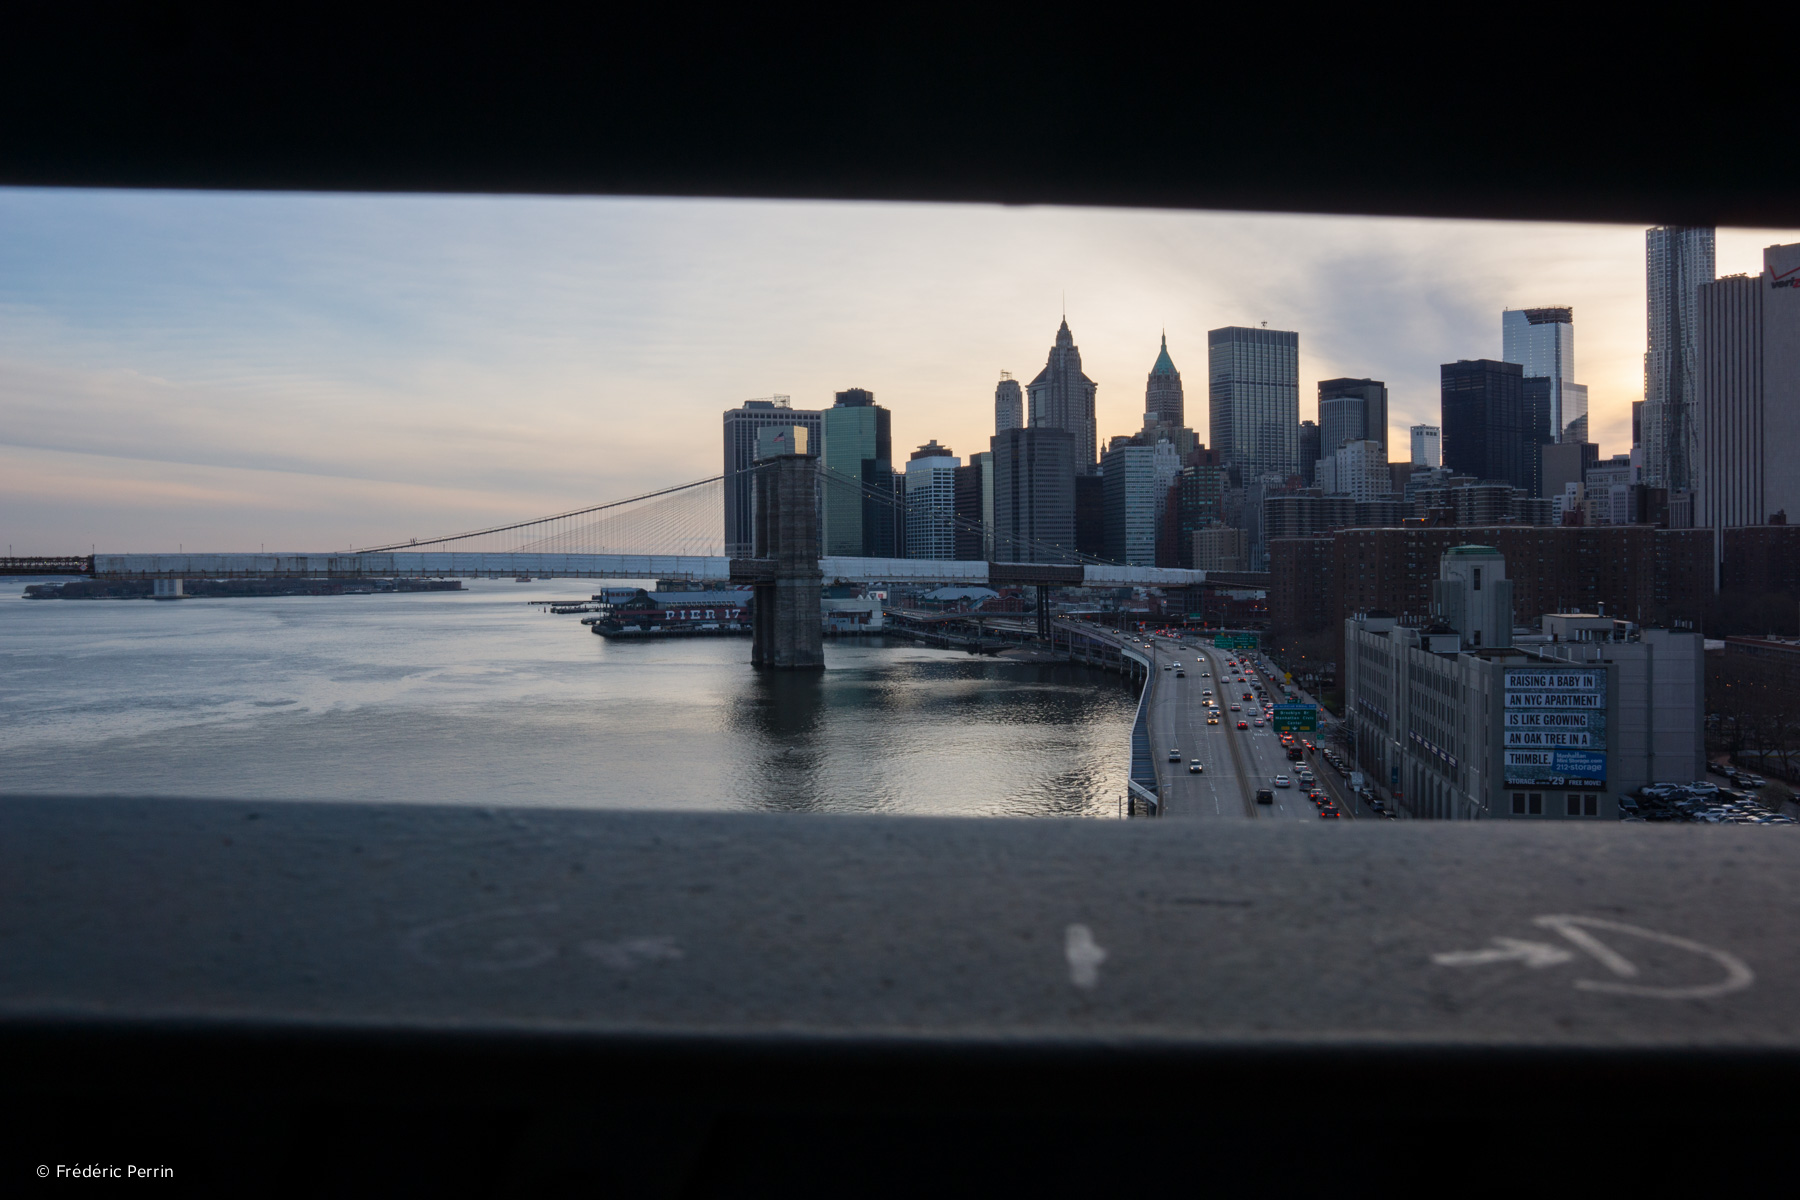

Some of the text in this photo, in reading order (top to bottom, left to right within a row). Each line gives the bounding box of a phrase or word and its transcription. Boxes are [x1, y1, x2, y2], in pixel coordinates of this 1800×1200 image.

[665, 609, 741, 620] PIER 17
[1510, 676, 1593, 687] RAISING A BABY IN
[1510, 695, 1598, 706] AN NYC APARTMENT
[1509, 714, 1586, 726] IS LIKE GROWING
[1509, 733, 1588, 745] AN OAK TREE IN A
[1509, 753, 1552, 765] THIMBLE.
[1548, 776, 1565, 786] $29
